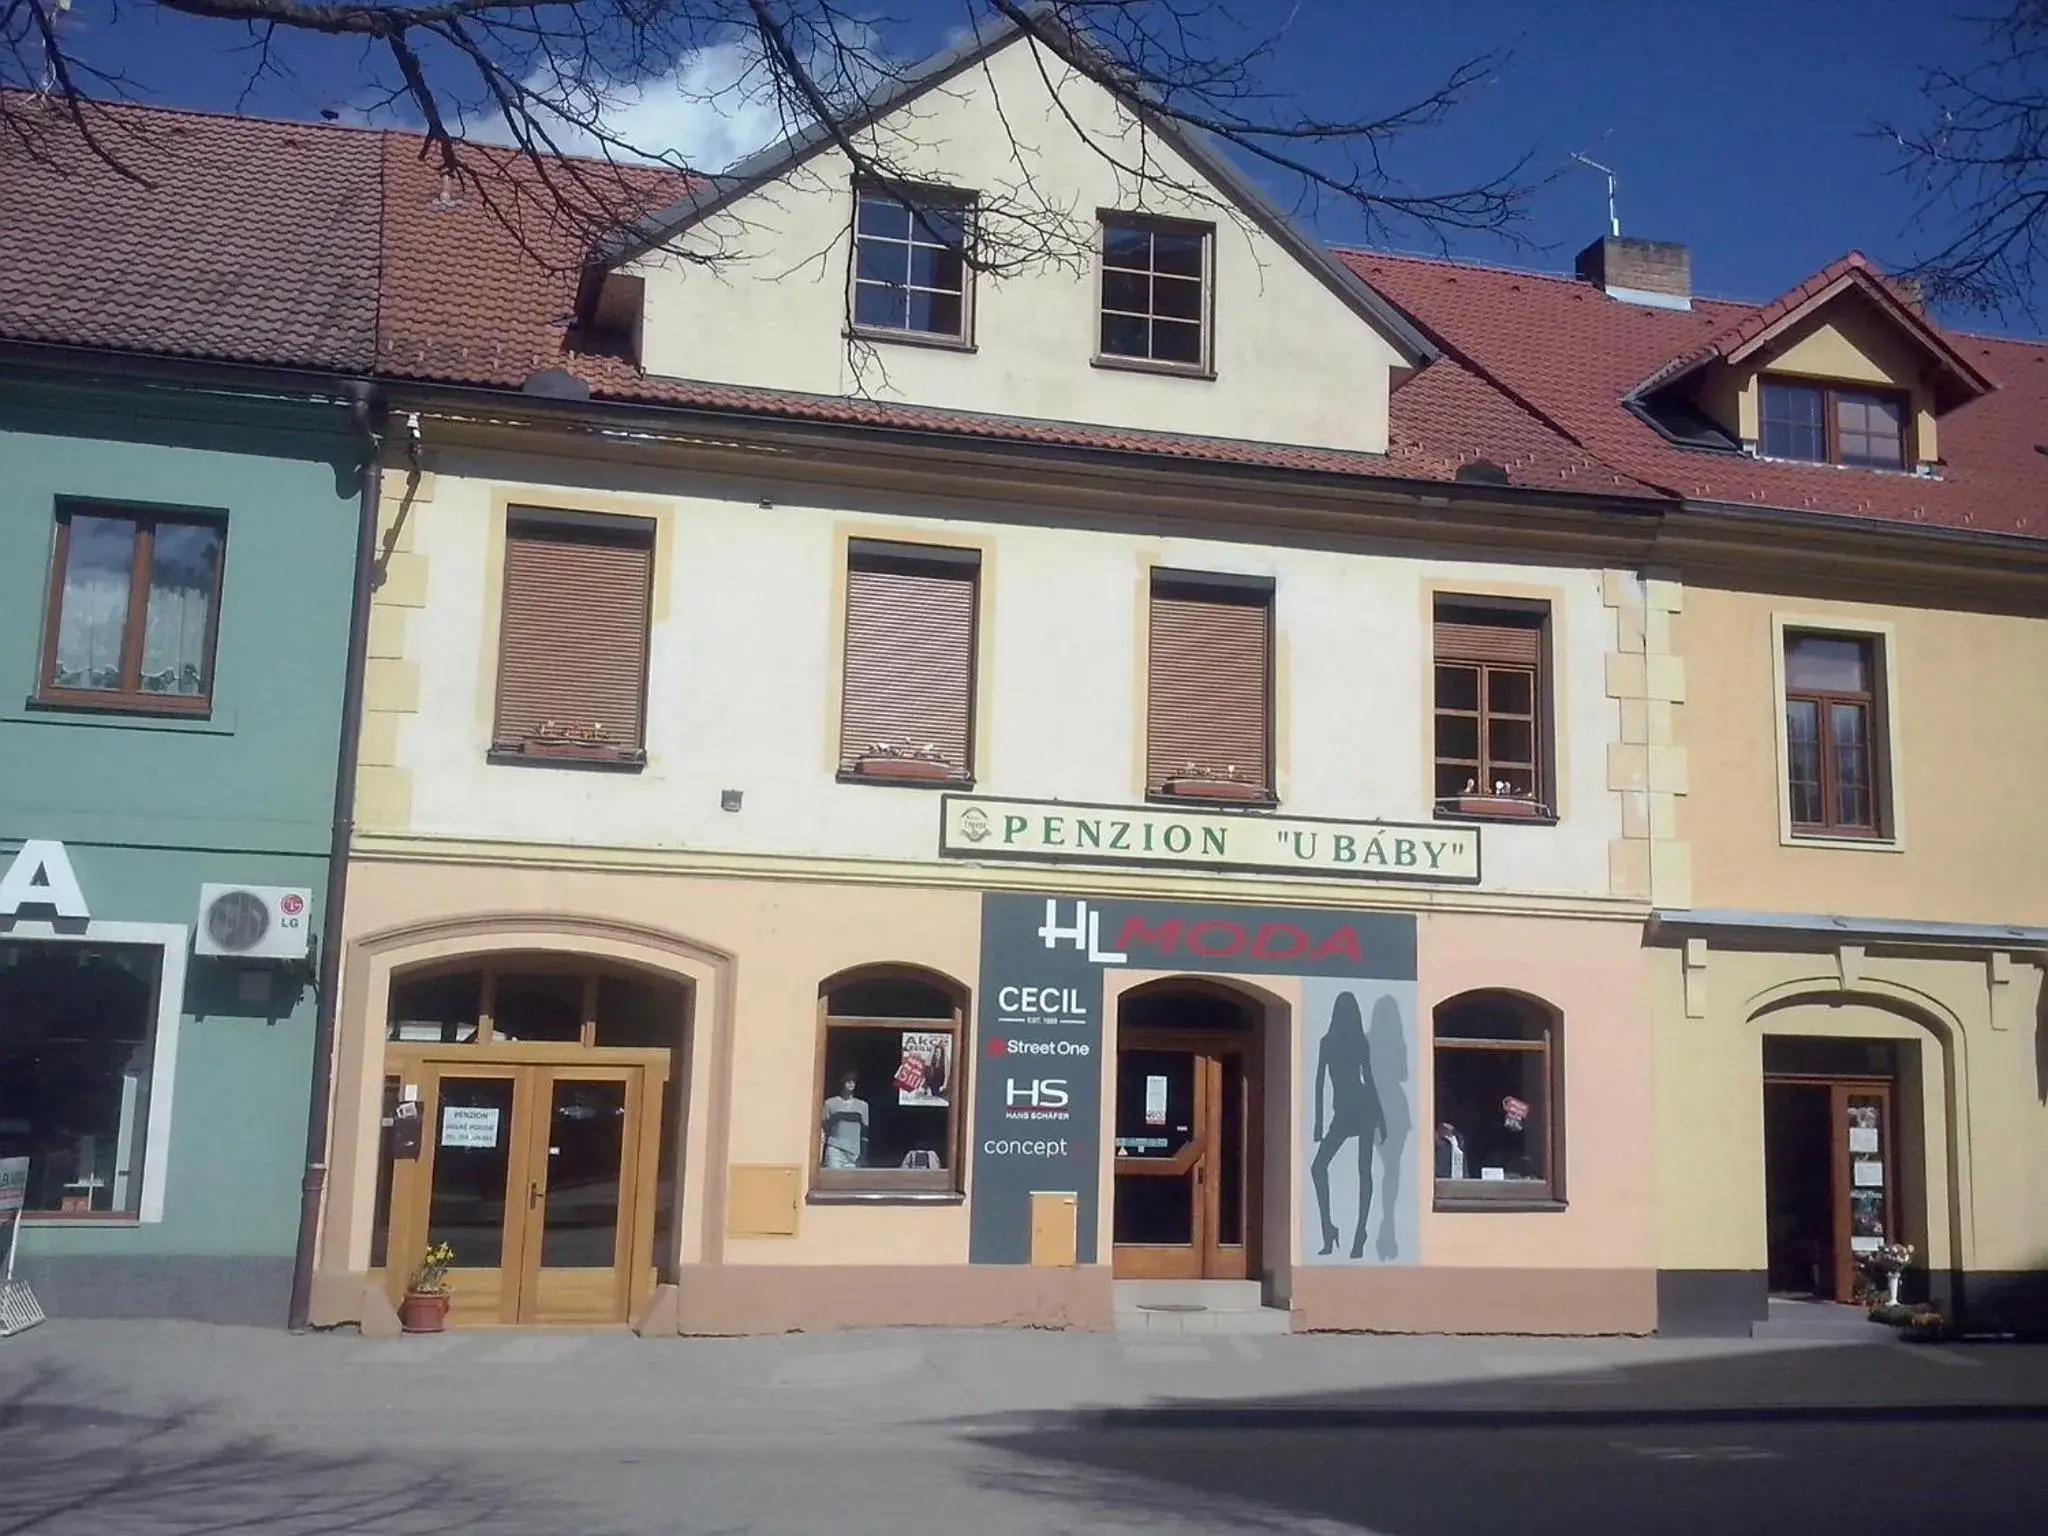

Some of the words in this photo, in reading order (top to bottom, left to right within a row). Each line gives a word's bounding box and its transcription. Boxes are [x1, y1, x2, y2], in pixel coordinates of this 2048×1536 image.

[1002, 814, 1228, 856] PENZION
[1332, 829, 1465, 869] BÁBY"
[0, 839, 90, 917] A
[280, 917, 299, 929] LG
[1037, 898, 1128, 963] HL
[1115, 914, 1364, 964] MODA
[998, 986, 1087, 1014] CECIL
[905, 1036, 949, 1047] Akce
[1006, 1039, 1056, 1055] Street
[1057, 1040, 1091, 1056] One
[1006, 1077, 1069, 1108] HS
[983, 1137, 1068, 1159] concept
